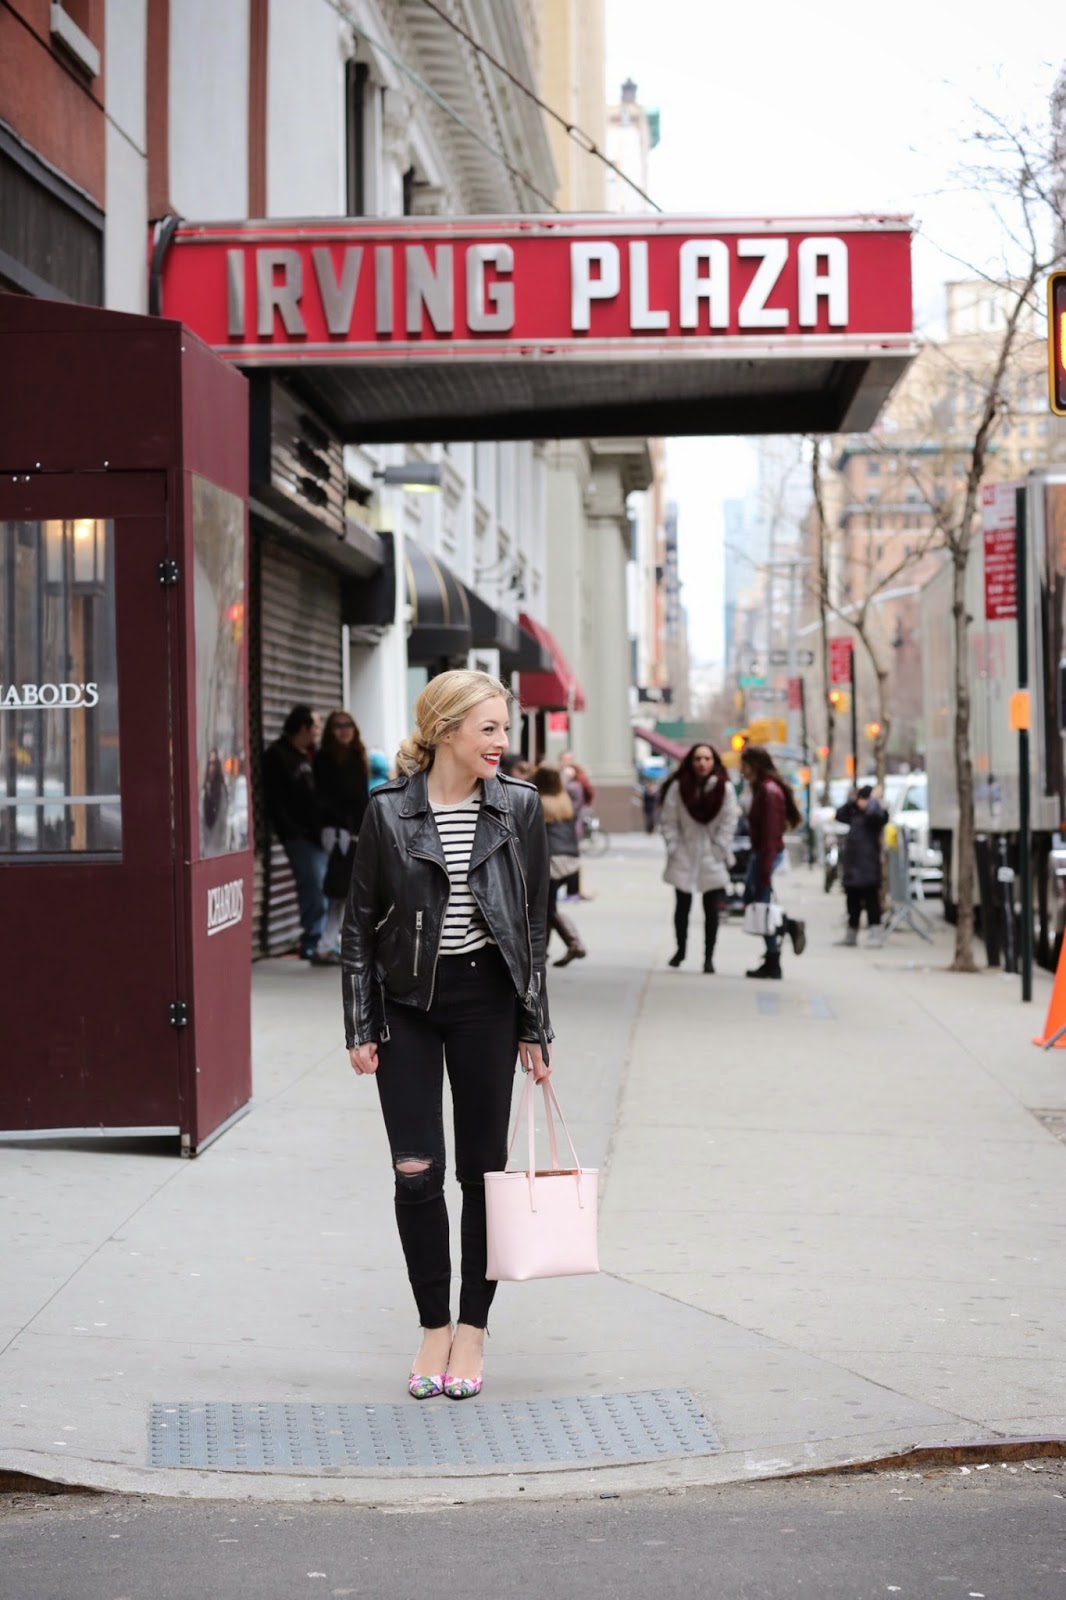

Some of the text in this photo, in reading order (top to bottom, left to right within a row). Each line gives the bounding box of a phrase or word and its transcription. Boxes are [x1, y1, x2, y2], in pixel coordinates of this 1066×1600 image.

[227, 237, 848, 336] IRVING PLAZA
[0, 682, 99, 708] ABOD'S
